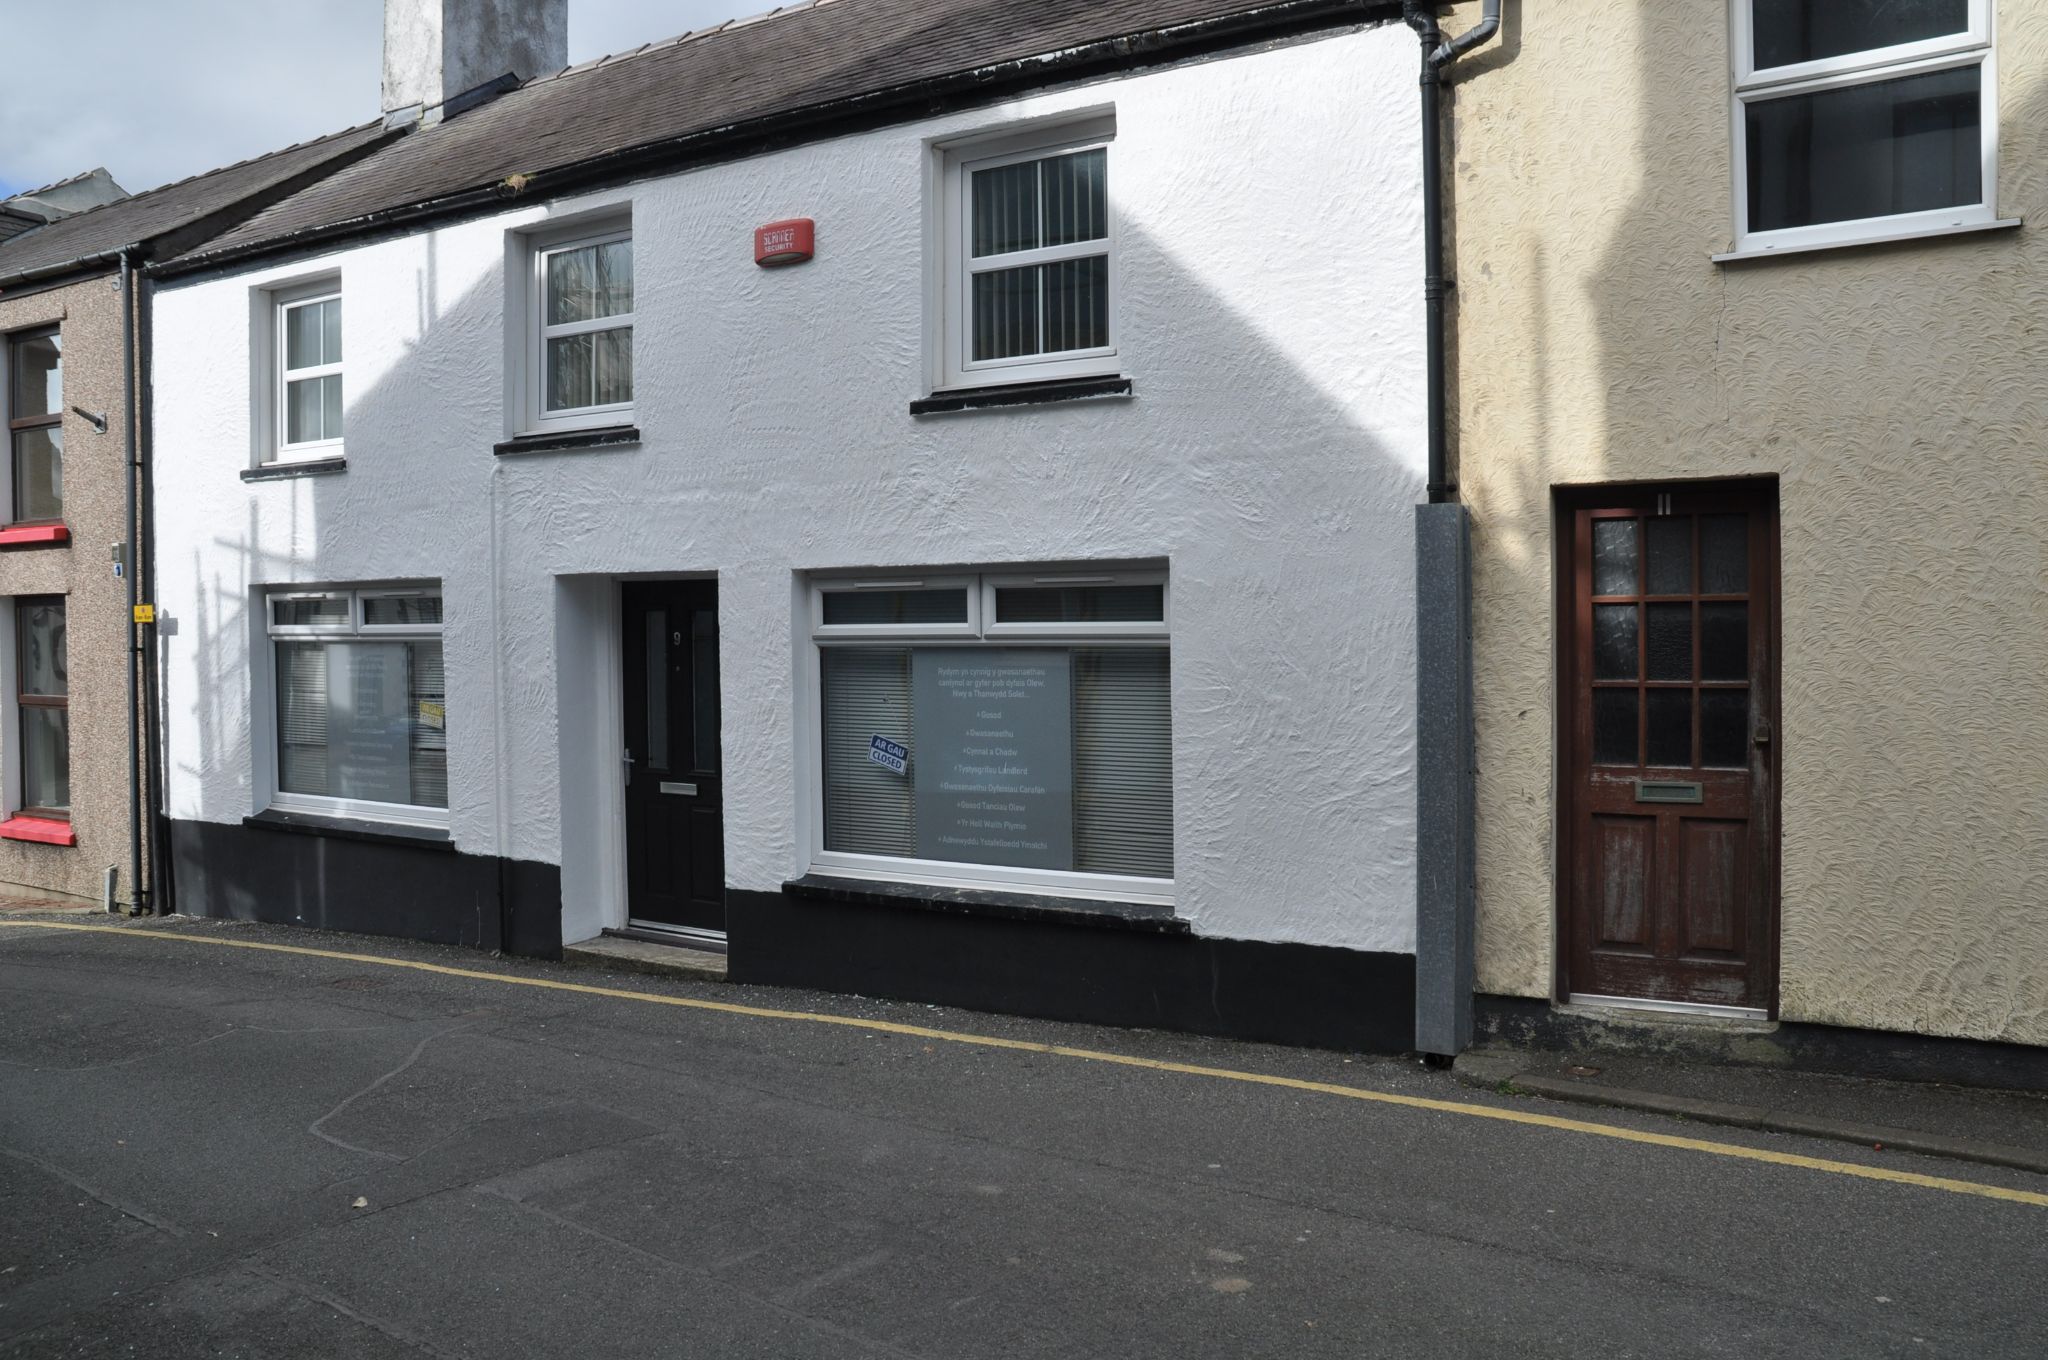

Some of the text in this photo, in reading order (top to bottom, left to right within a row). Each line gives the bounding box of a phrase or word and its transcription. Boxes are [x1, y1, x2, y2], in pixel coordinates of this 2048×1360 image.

[764, 242, 793, 253] SECURITY
[673, 631, 681, 646] 9
[992, 679, 1005, 688] pob
[874, 739, 905, 758] AR GAU
[872, 750, 902, 769] CLOSED
